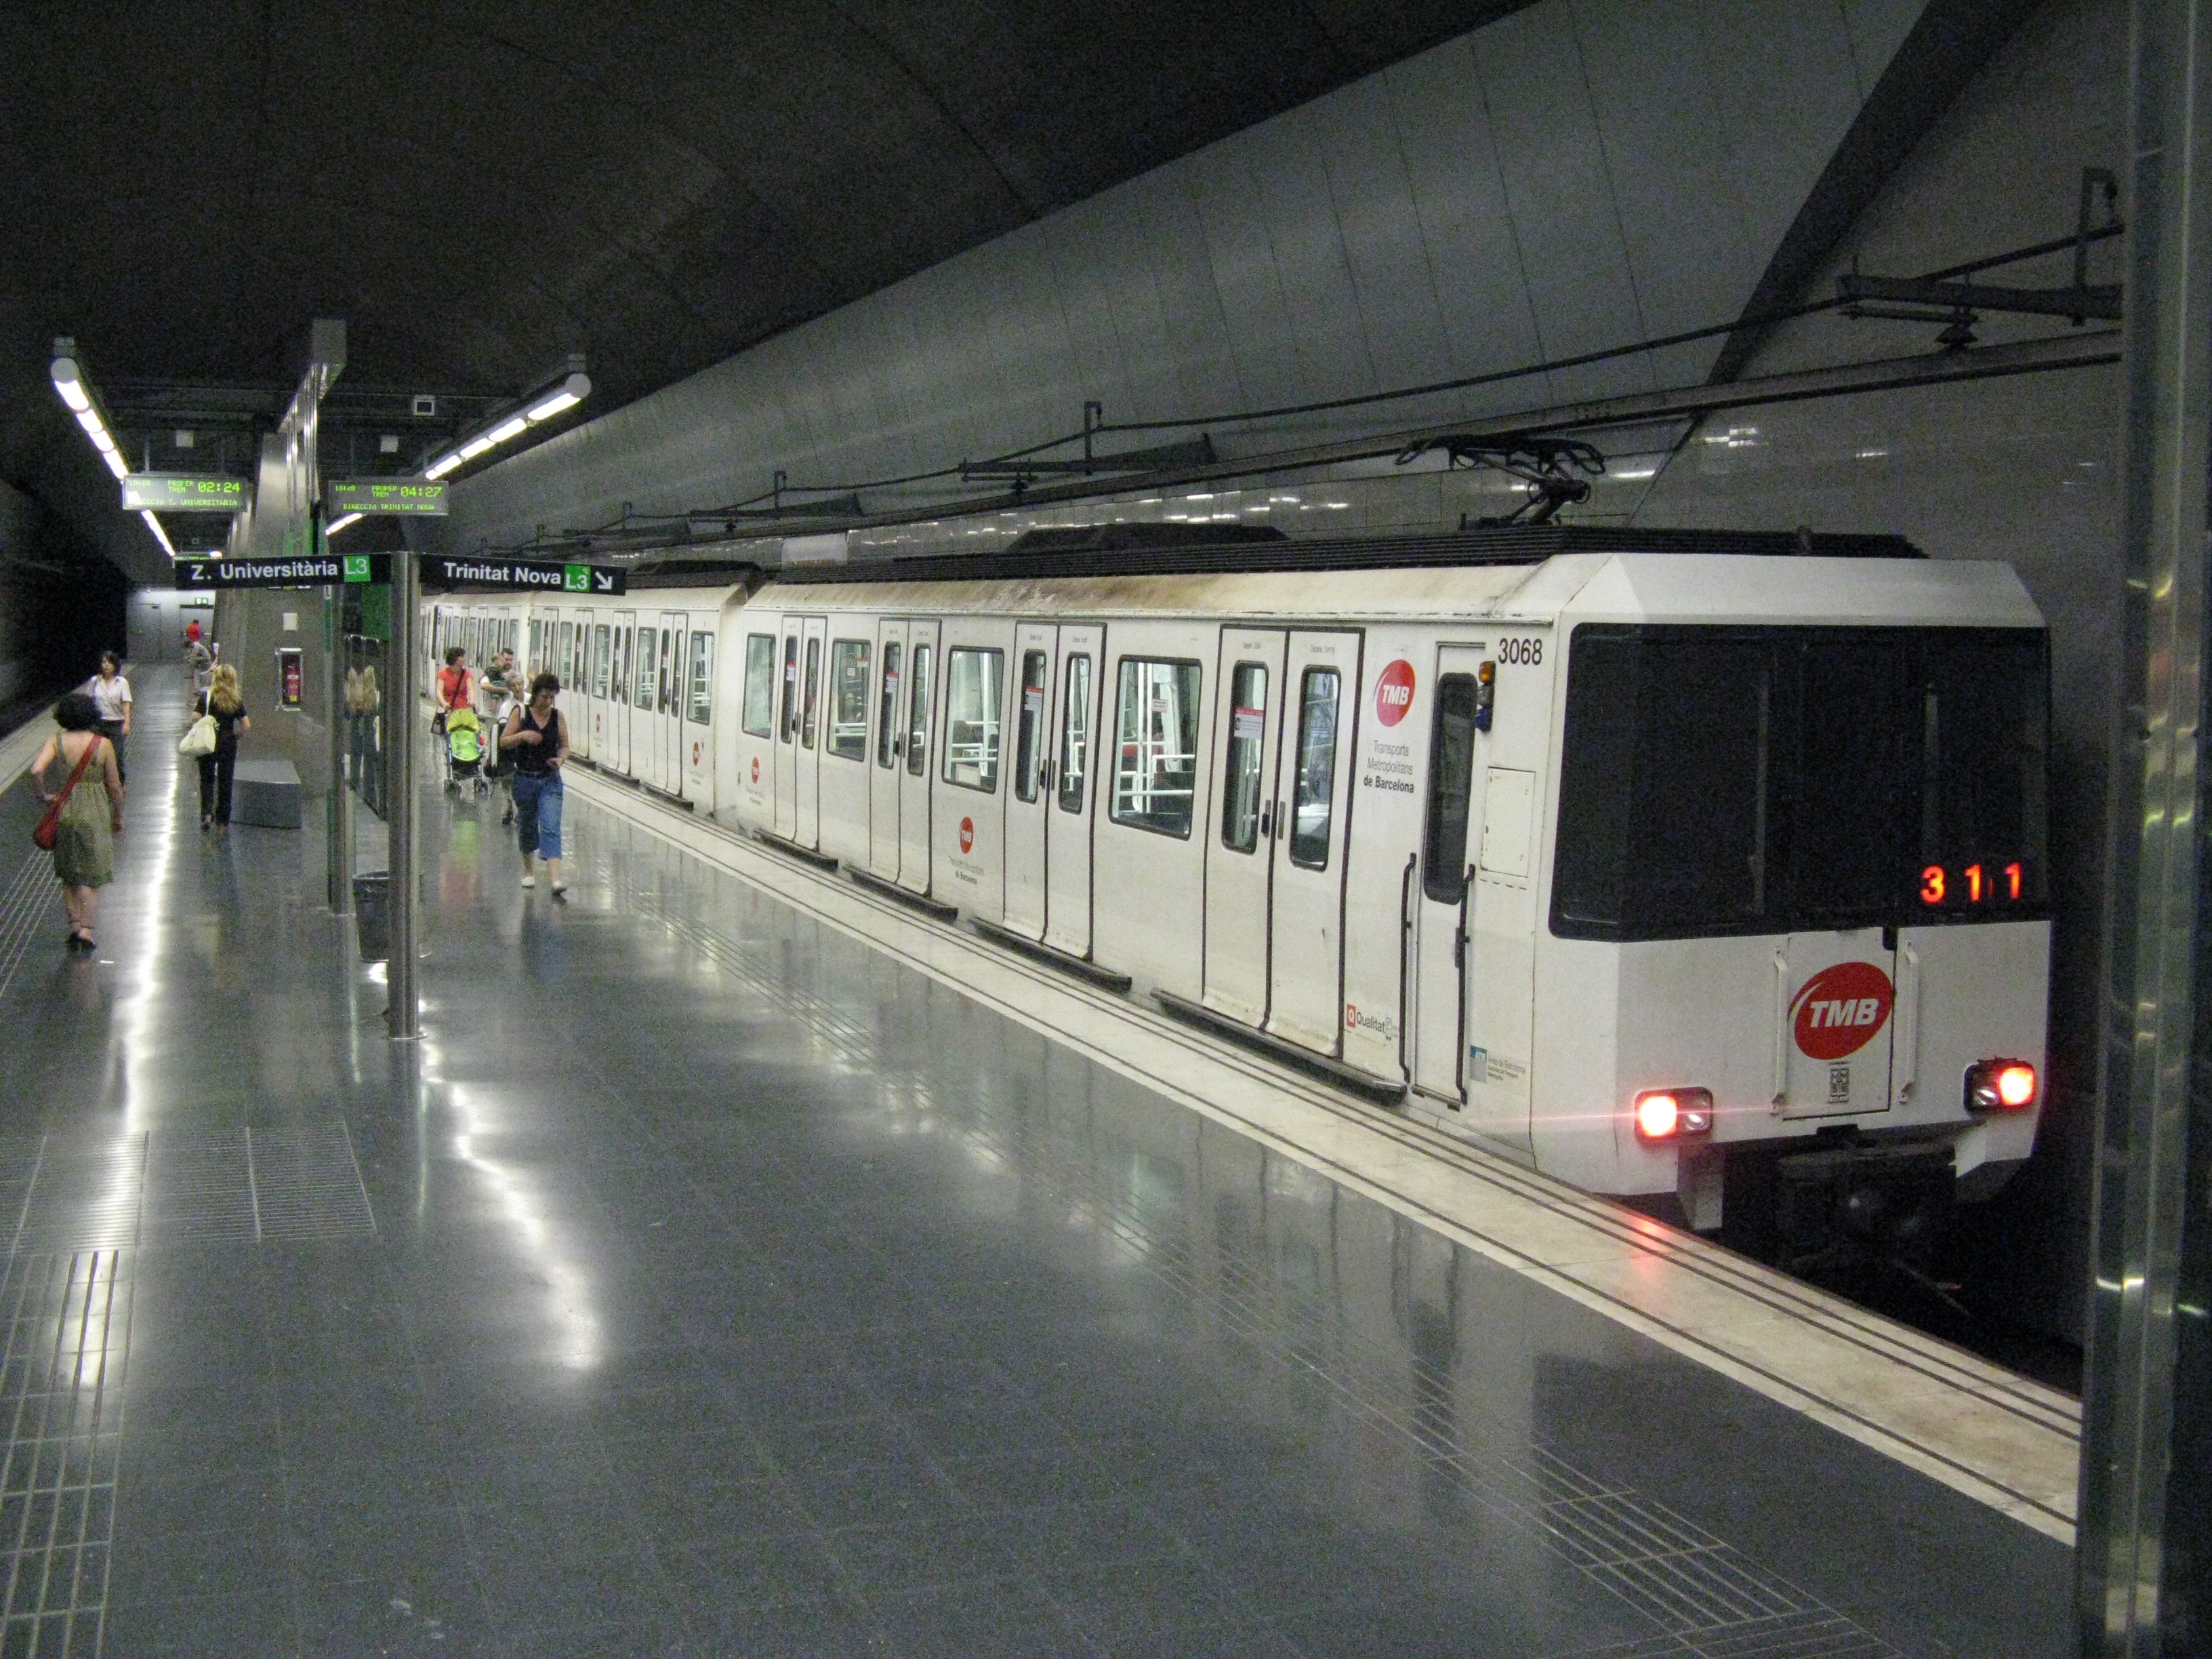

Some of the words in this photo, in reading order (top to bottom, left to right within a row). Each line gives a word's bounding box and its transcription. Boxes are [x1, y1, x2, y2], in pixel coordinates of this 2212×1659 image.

[198, 481, 241, 493] 02:24
[401, 486, 443, 498] 04:27
[191, 565, 211, 580] Z.
[220, 560, 338, 579] Universitària
[345, 558, 369, 575] L3
[444, 562, 510, 581] Trinitat
[515, 567, 561, 584] Nova
[566, 573, 588, 590] L3
[1498, 638, 1543, 665] 3068
[1382, 684, 1410, 705] TMB
[1373, 739, 1410, 757] Transports
[1366, 756, 1414, 776] Metropolitans
[1363, 775, 1374, 787] de
[1375, 776, 1415, 794] Barcelona
[1356, 1011, 1385, 1033] Qualitat
[1809, 998, 1880, 1029] TMB
